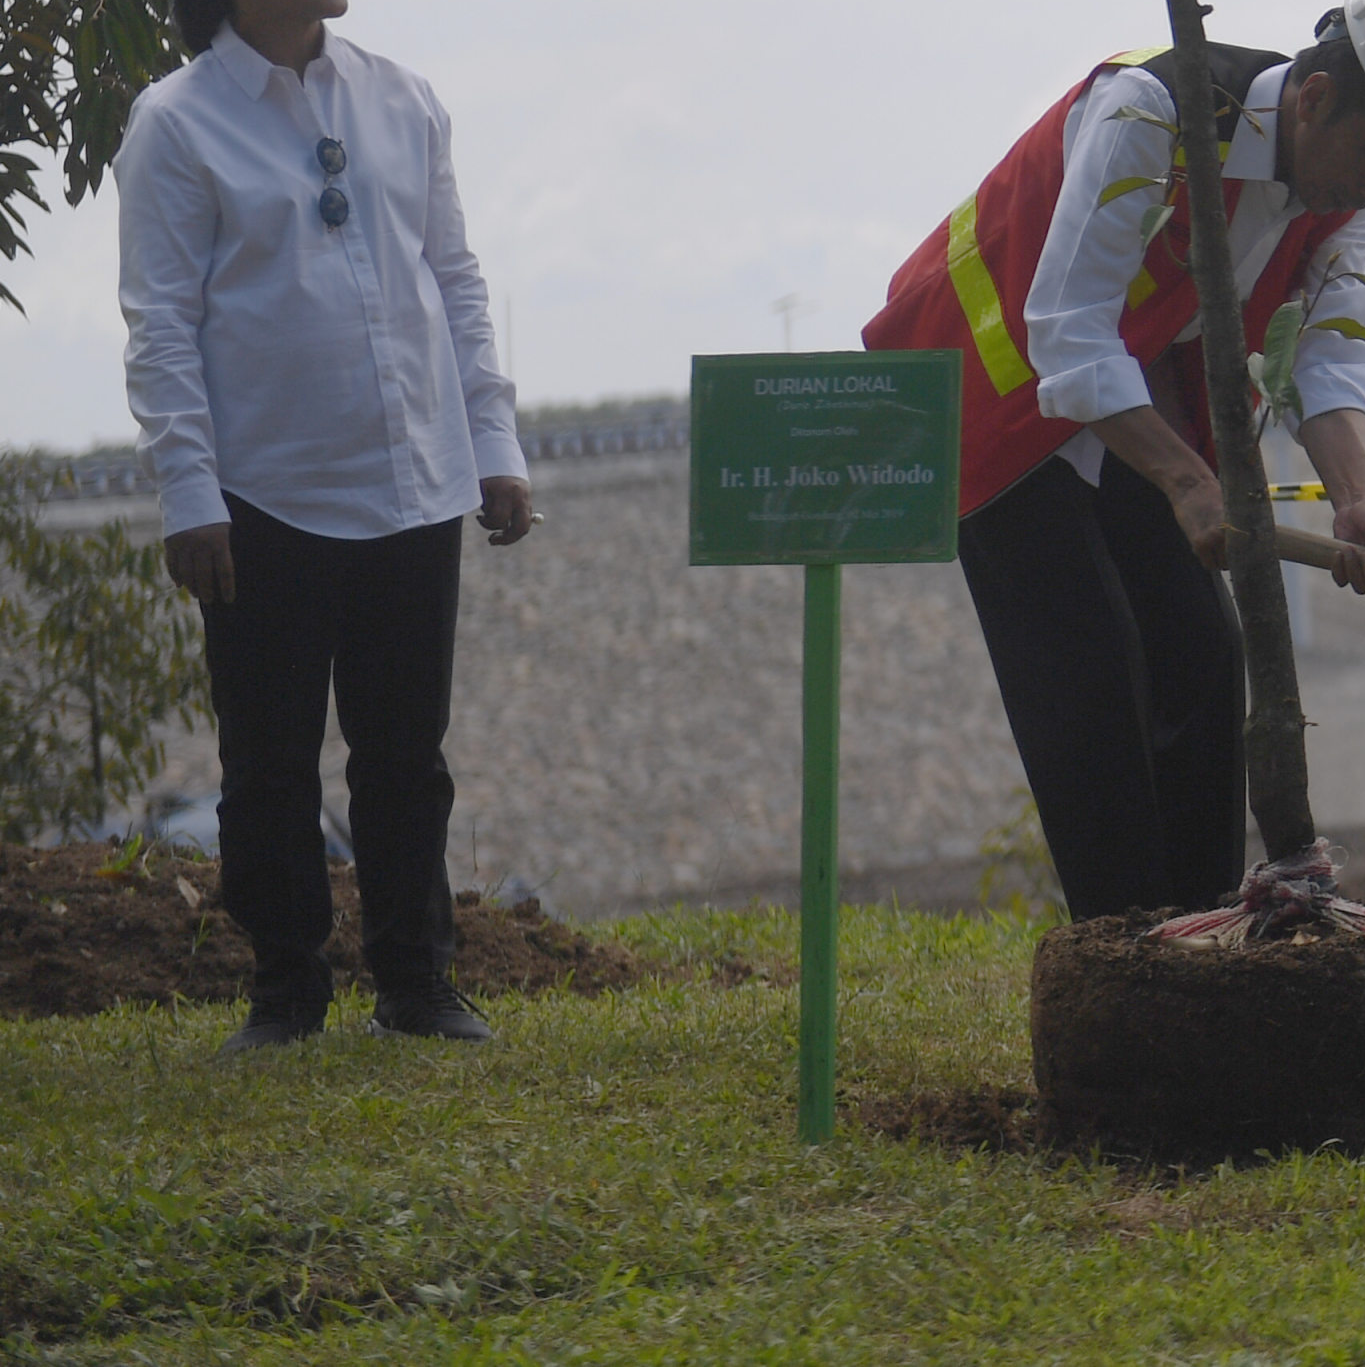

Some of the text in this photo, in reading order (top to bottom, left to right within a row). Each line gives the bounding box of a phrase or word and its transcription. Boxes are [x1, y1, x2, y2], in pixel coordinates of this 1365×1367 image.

[754, 375, 897, 395] DURIAN LOKAL
[719, 464, 934, 488] Ir. H. Joko Widodo
